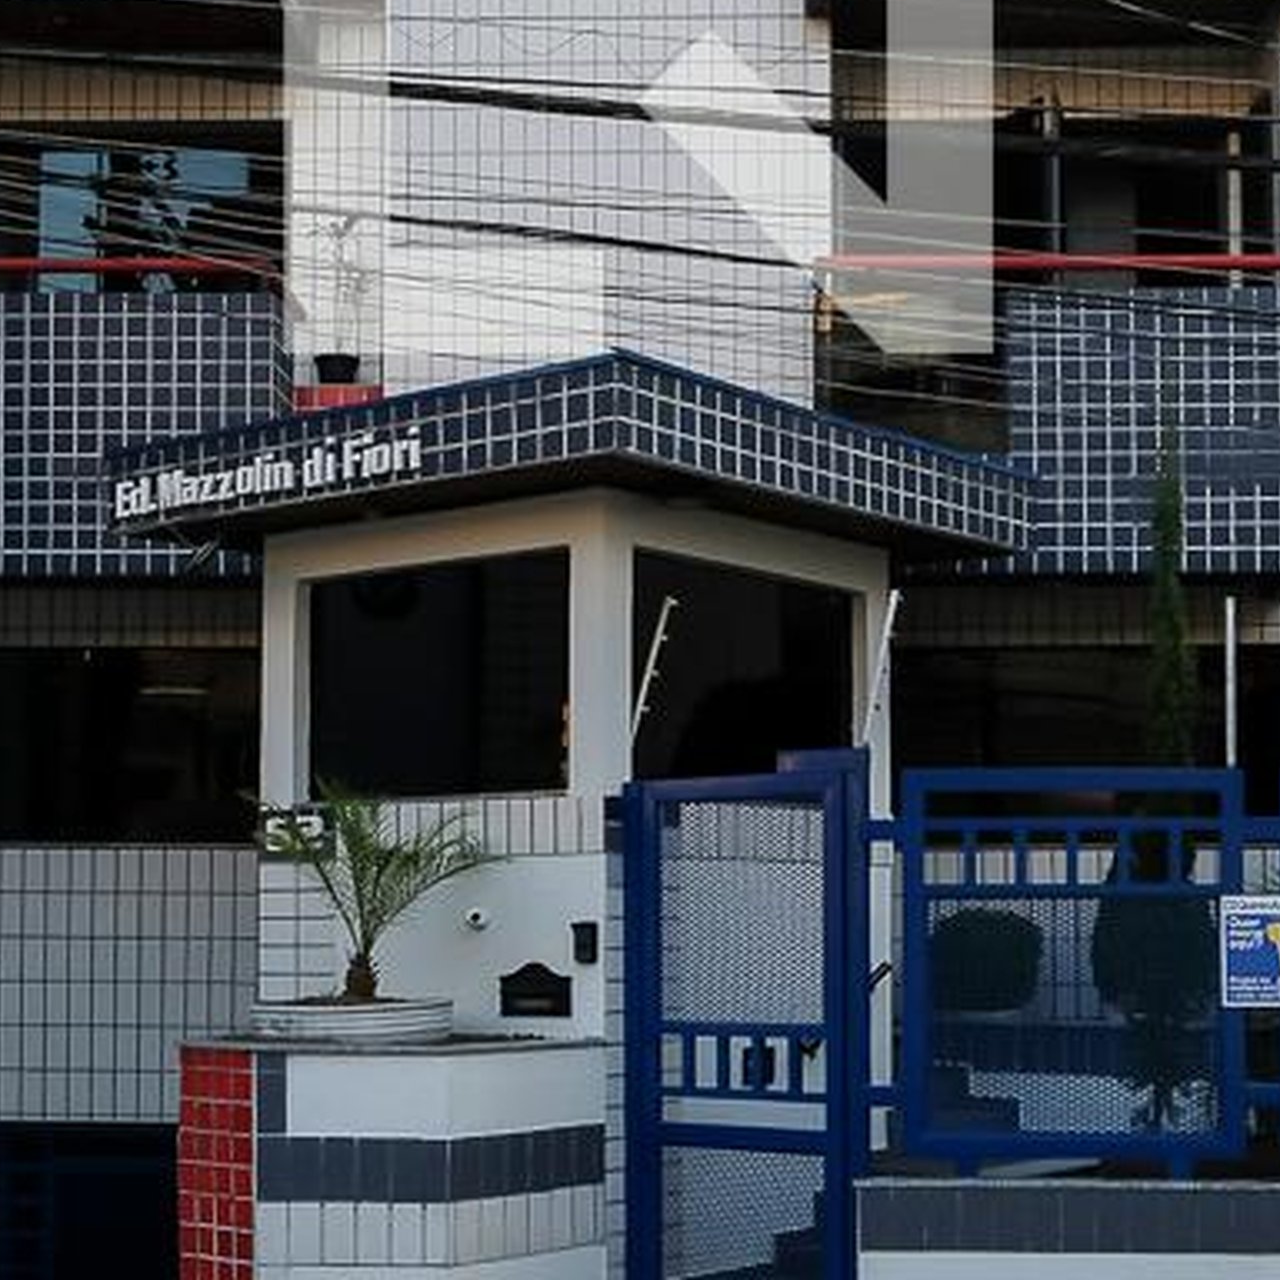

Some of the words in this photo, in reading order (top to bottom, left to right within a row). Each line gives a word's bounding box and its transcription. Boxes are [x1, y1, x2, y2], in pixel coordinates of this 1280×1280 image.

[115, 476, 158, 518] Ed.
[156, 452, 295, 508] Mazzolin
[303, 436, 336, 488] di
[343, 426, 422, 480] Fiori
